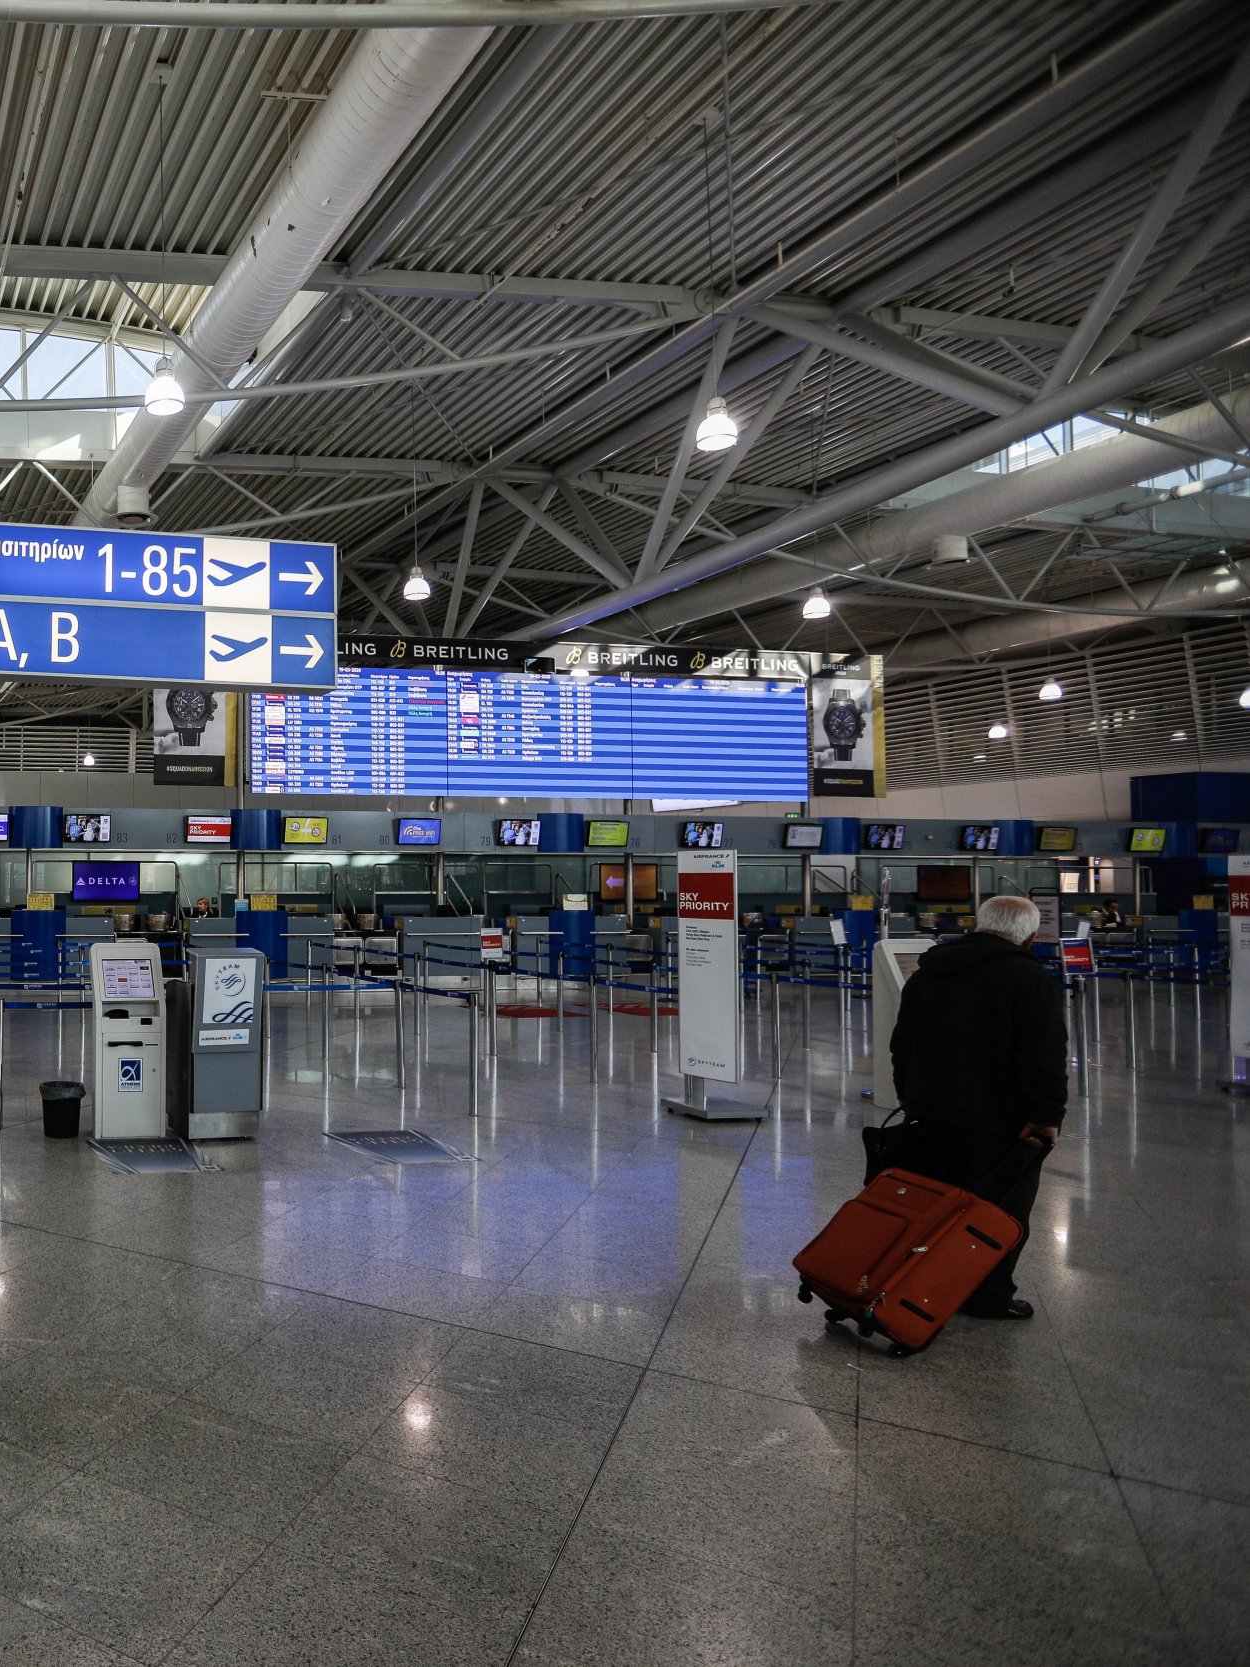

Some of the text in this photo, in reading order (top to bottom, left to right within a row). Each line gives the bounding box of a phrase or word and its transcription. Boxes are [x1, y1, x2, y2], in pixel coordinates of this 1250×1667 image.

[97, 544, 198, 598] 1-85
[51, 611, 80, 663] B
[412, 645, 510, 662] BREITLING
[587, 651, 678, 668] BREITLING
[711, 656, 799, 673] BREITLING
[822, 663, 861, 672] BREITLING
[116, 832, 128, 843] 83
[166, 833, 178, 844] 82
[332, 835, 342, 844] 81
[380, 836, 390, 845] 80
[480, 836, 491, 846] 79
[630, 838, 640, 848] 78
[766, 839, 776, 848] 76
[88, 877, 126, 886] DELTA
[680, 892, 699, 901] SKY
[680, 902, 730, 911] PRIORITY
[214, 964, 241, 990] SKYTEAM
